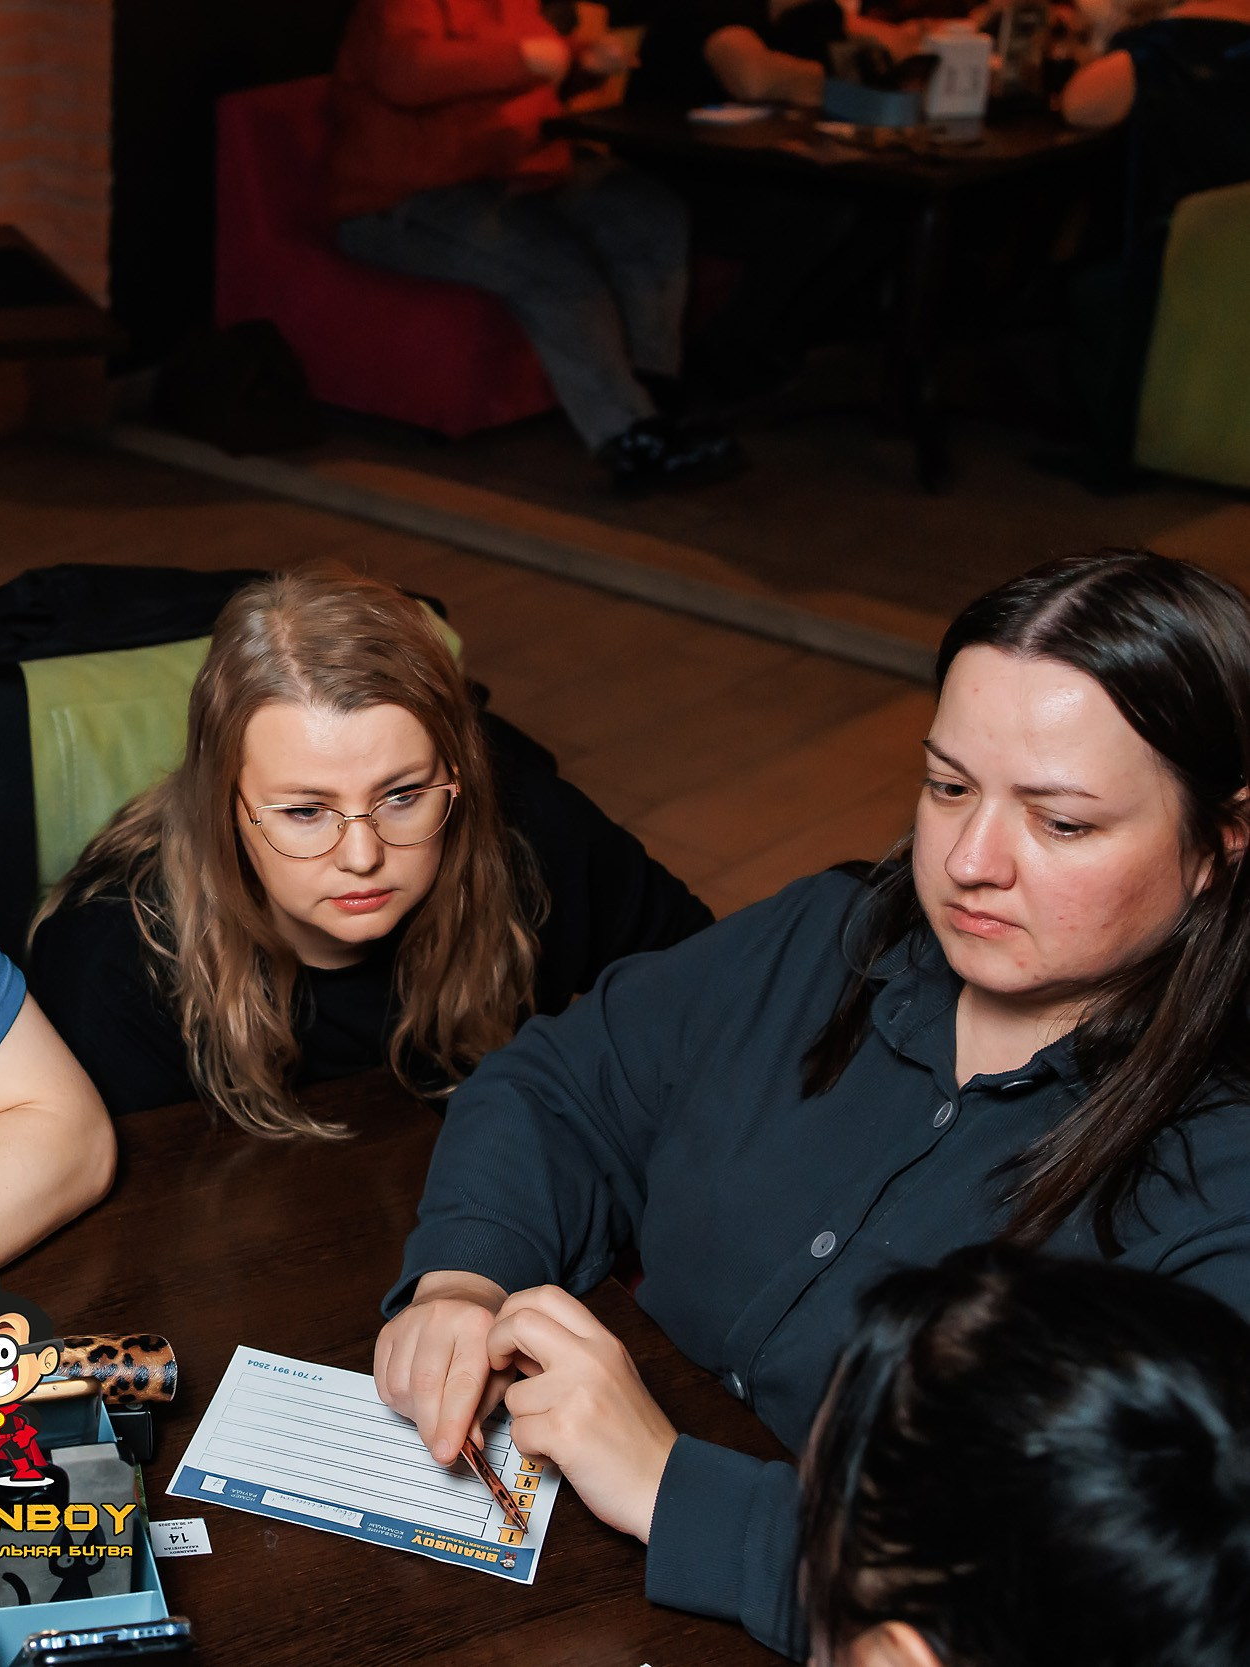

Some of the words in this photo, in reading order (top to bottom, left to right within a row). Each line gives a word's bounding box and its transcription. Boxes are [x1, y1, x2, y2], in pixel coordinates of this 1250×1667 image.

[247, 1359, 271, 1370] 2504
[273, 1365, 290, 1375] 991
[292, 1370, 309, 1379] 701
[523, 1476, 532, 1488] 4
[518, 1495, 528, 1506] 3
[169, 1533, 189, 1544] 14
[507, 1531, 514, 1542] 1
[411, 1534, 499, 1563] BRAINBOY
